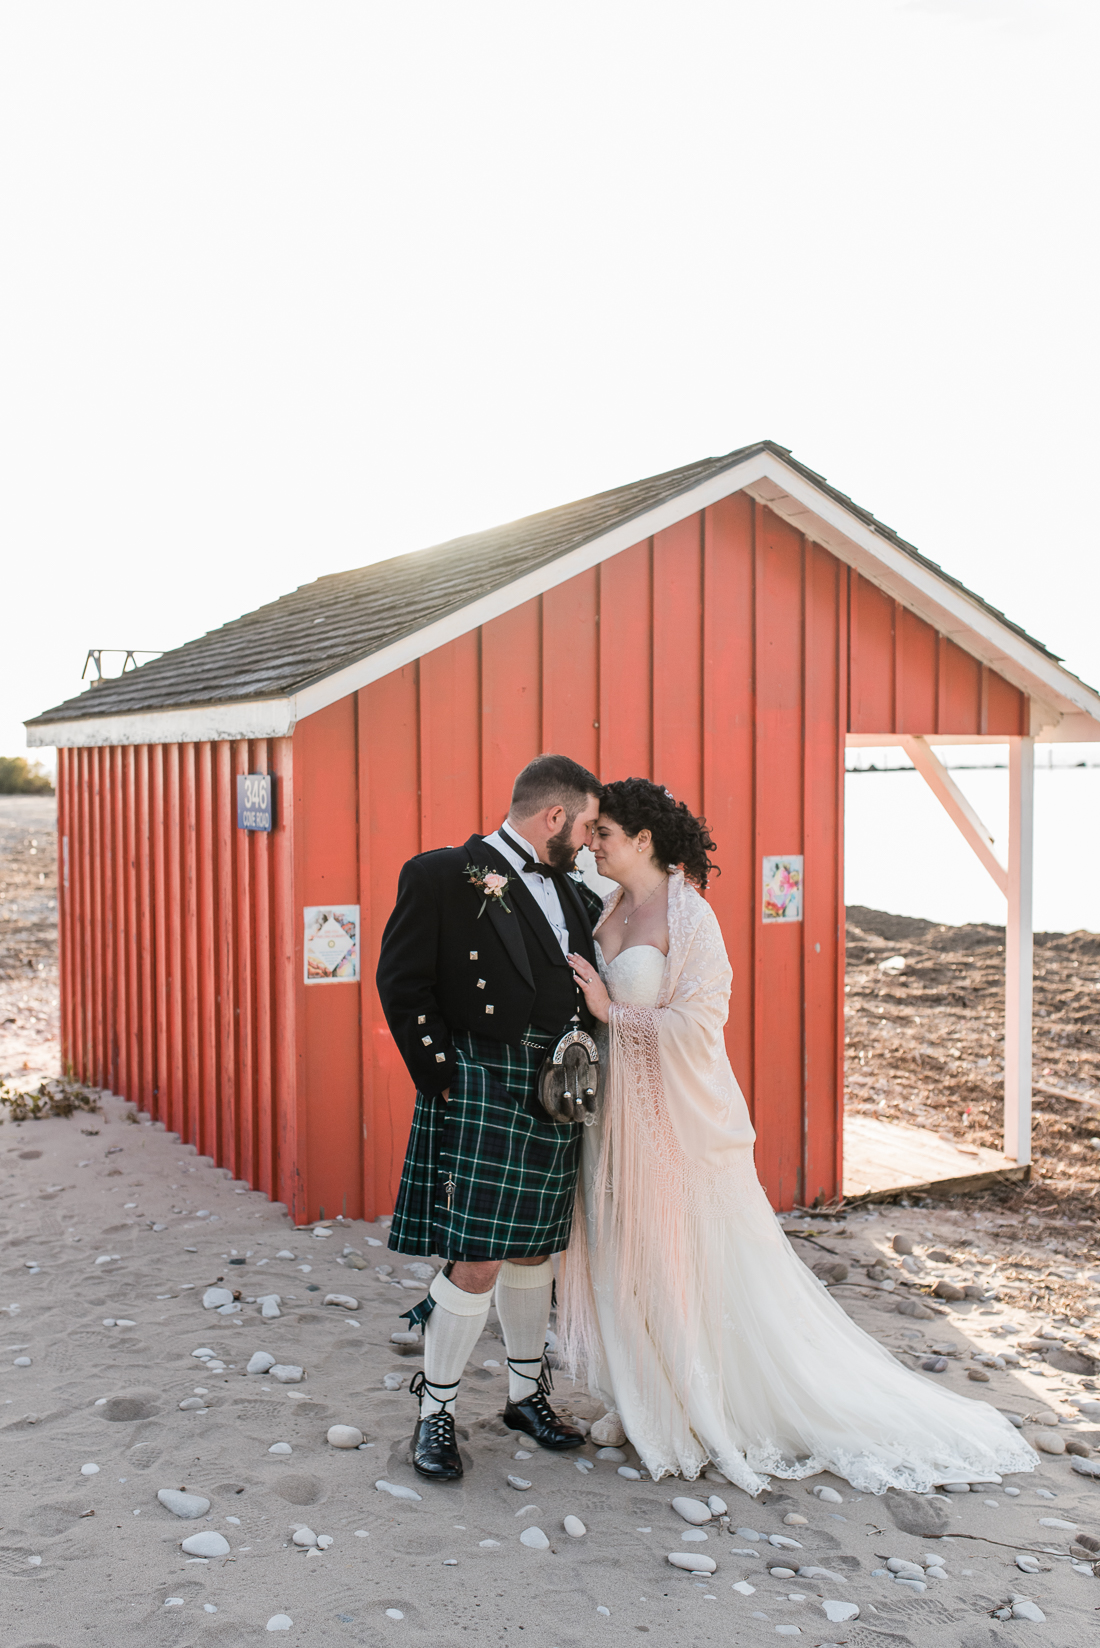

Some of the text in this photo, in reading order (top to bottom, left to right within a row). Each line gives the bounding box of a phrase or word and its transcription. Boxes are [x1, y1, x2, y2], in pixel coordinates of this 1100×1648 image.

[245, 780, 267, 809] 346
[243, 811, 269, 828] COVE ROAD
